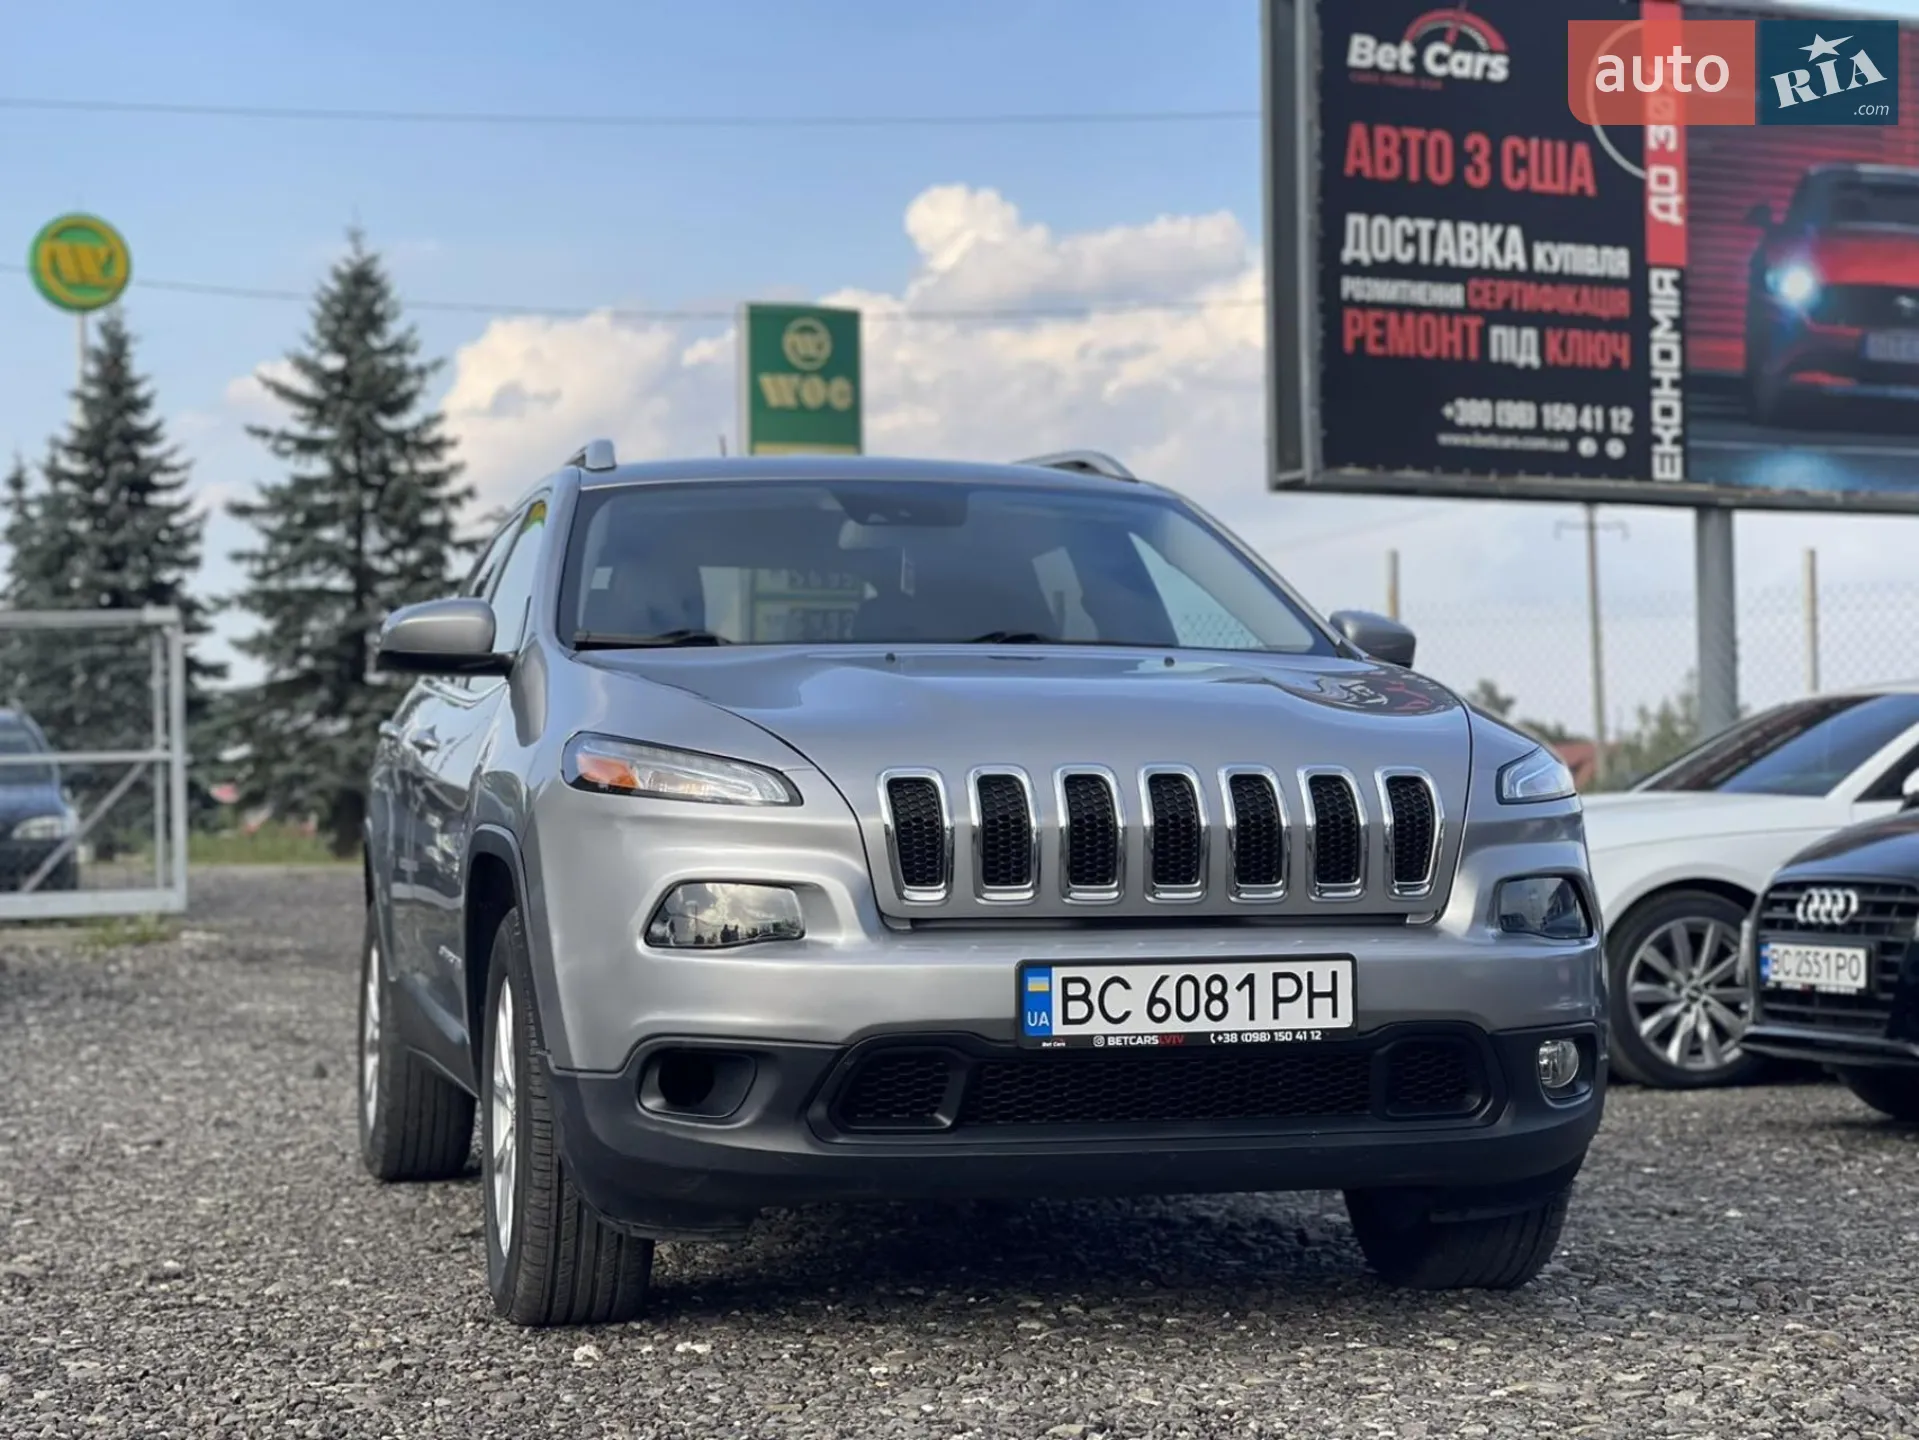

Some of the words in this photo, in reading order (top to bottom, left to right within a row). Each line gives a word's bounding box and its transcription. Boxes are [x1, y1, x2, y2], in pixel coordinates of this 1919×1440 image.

[1347, 33, 1416, 73] Bet
[1423, 41, 1510, 82] Cars
[1344, 121, 1454, 186] АВТО
[1501, 135, 1598, 197] США
[1648, 165, 1684, 226] ДО
[1341, 213, 1526, 271] ДОСТАВКА
[1532, 241, 1630, 279] КУПІВЛЯ
[1342, 308, 1483, 361] РЕМОНТ
[1489, 325, 1540, 369] ПІД
[1545, 327, 1630, 369] КЛЮЧ
[1649, 268, 1684, 482] ЕКОНОМІЯ
[1541, 402, 1577, 431] 150
[1579, 404, 1603, 432] 41
[1609, 406, 1634, 434] 12
[1027, 1011, 1049, 1027] UA
[1061, 975, 1132, 1026] BC
[1146, 973, 1256, 1024] 6081
[1272, 970, 1339, 1020] PH
[1217, 1032, 1238, 1043] +38
[1241, 1032, 1270, 1043] (098)
[1273, 1031, 1293, 1042] 150
[1295, 1031, 1307, 1041] 41
[1310, 1030, 1322, 1041] 12
